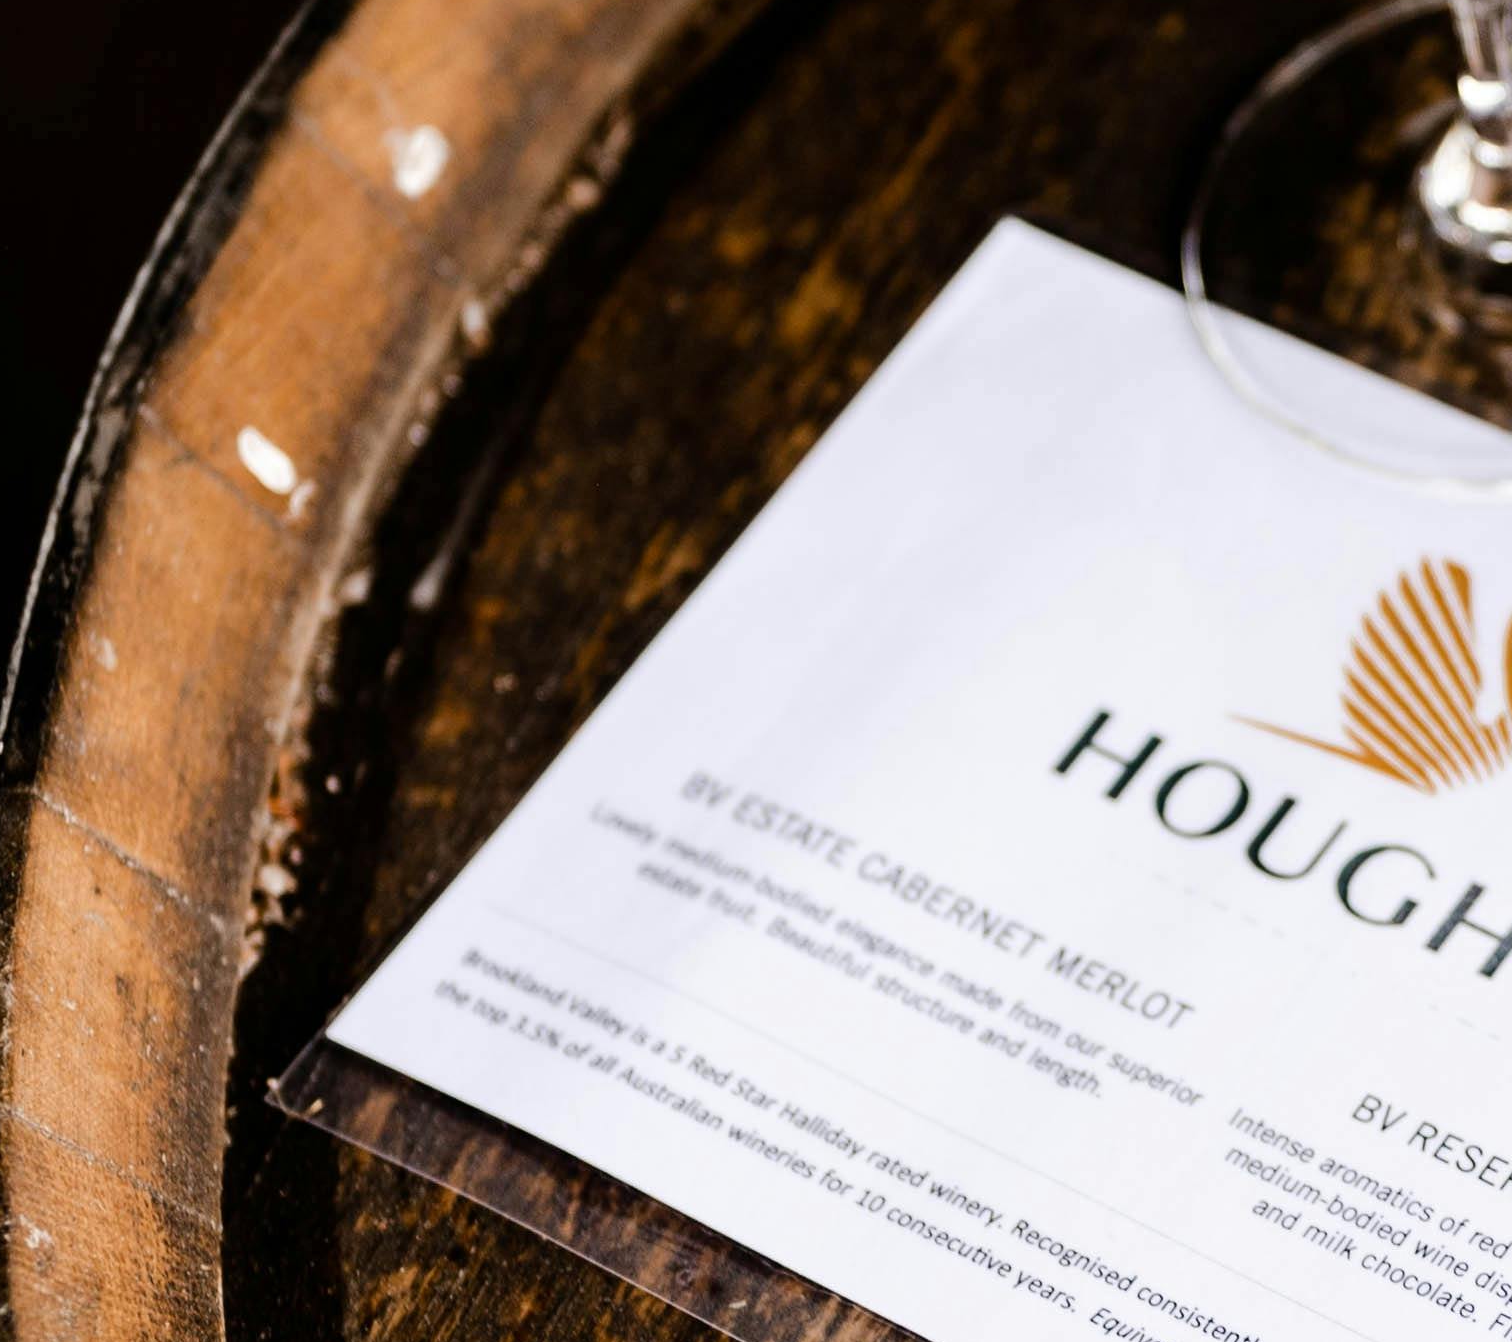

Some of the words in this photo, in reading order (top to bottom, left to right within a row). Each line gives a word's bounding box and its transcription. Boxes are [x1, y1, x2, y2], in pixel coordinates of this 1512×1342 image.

[636, 862, 704, 900] estate
[765, 916, 873, 981] Beautiful
[871, 973, 976, 1035] structure
[977, 1028, 1027, 1059] and
[1026, 1047, 1101, 1099] length.
[663, 838, 835, 924] medium-bodied
[835, 919, 936, 978] elegance
[939, 971, 1004, 1012] made
[1007, 1000, 1062, 1040] from
[1064, 1032, 1106, 1059] our
[1106, 1052, 1205, 1107] superior
[679, 770, 734, 809] BV
[731, 793, 857, 868] ESTATE
[857, 852, 1046, 957] CABERNET
[1046, 946, 1195, 1029] MERLOT
[434, 980, 471, 1007] the
[562, 1042, 592, 1060] of
[588, 1054, 620, 1074] all
[616, 1066, 724, 1130] Australian
[727, 1125, 817, 1179] wineries
[819, 1169, 854, 1196] for
[855, 1190, 887, 1213] 10
[886, 1208, 1012, 1278] consecutive
[1013, 1270, 1076, 1313] years.
[461, 947, 568, 1007] Brookland
[568, 995, 630, 1038] Valley
[630, 1027, 649, 1046] is
[650, 1040, 667, 1055] a
[668, 1045, 687, 1064] 5
[687, 1054, 734, 1088] Red
[730, 1077, 778, 1110] Star
[778, 1102, 866, 1159] Halliday
[867, 1151, 929, 1188] rated
[928, 1181, 1003, 1229] winery.
[1011, 1219, 1138, 1292] Recognised
[1225, 1147, 1412, 1247] medium-bodied
[1414, 1240, 1469, 1277] wine
[1229, 1108, 1316, 1164] Intense
[1319, 1157, 1435, 1223] aromatics
[1439, 1217, 1470, 1236] of
[1468, 1231, 1512, 1260] red
[1352, 1094, 1407, 1132] BV
[1251, 1200, 1302, 1231] and
[1302, 1225, 1357, 1260] milk
[1360, 1253, 1477, 1323] chocolate.
